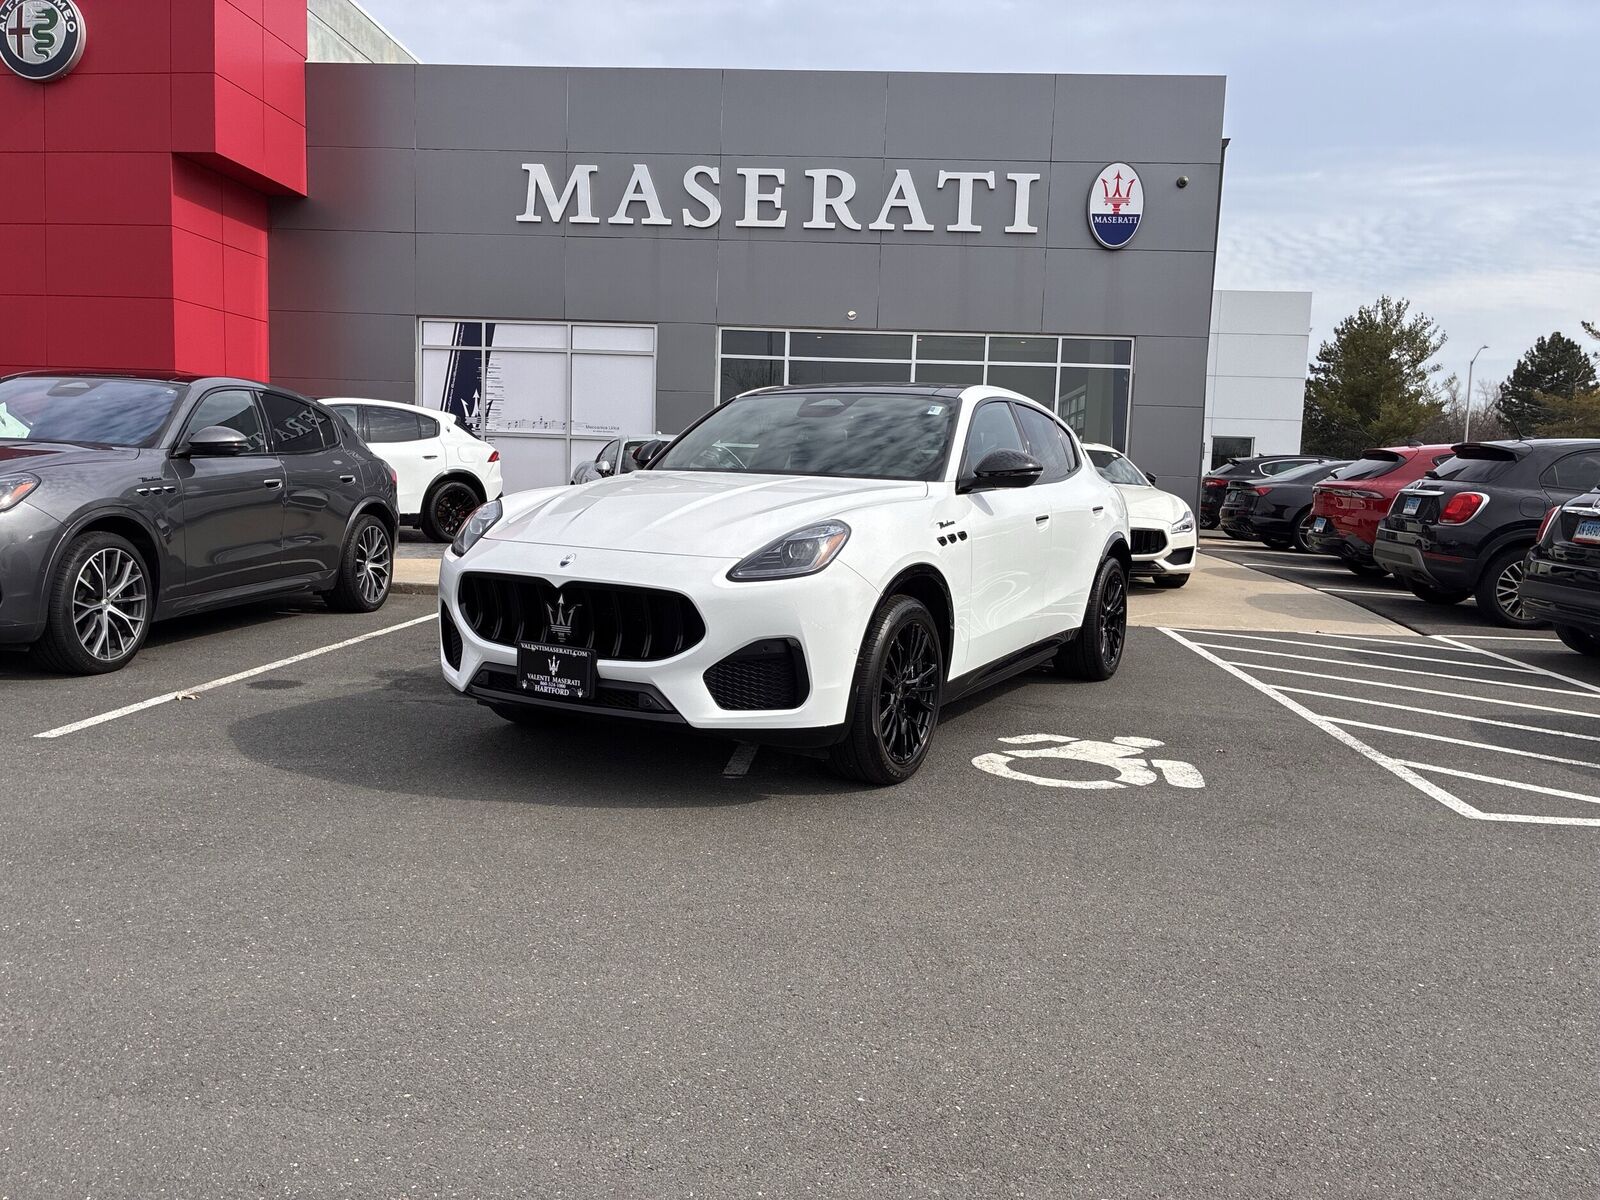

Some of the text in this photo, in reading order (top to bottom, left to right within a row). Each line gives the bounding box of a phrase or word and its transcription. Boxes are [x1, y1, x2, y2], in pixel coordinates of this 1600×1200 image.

[0, 0, 77, 33] ALF MEO
[515, 163, 1041, 234] MASERATI
[1094, 216, 1138, 224] MASERATI
[520, 643, 588, 657] VALENTIMASERATI.COM
[527, 673, 580, 686] VALENTI MASERATI
[534, 685, 570, 695] HARTFORD
